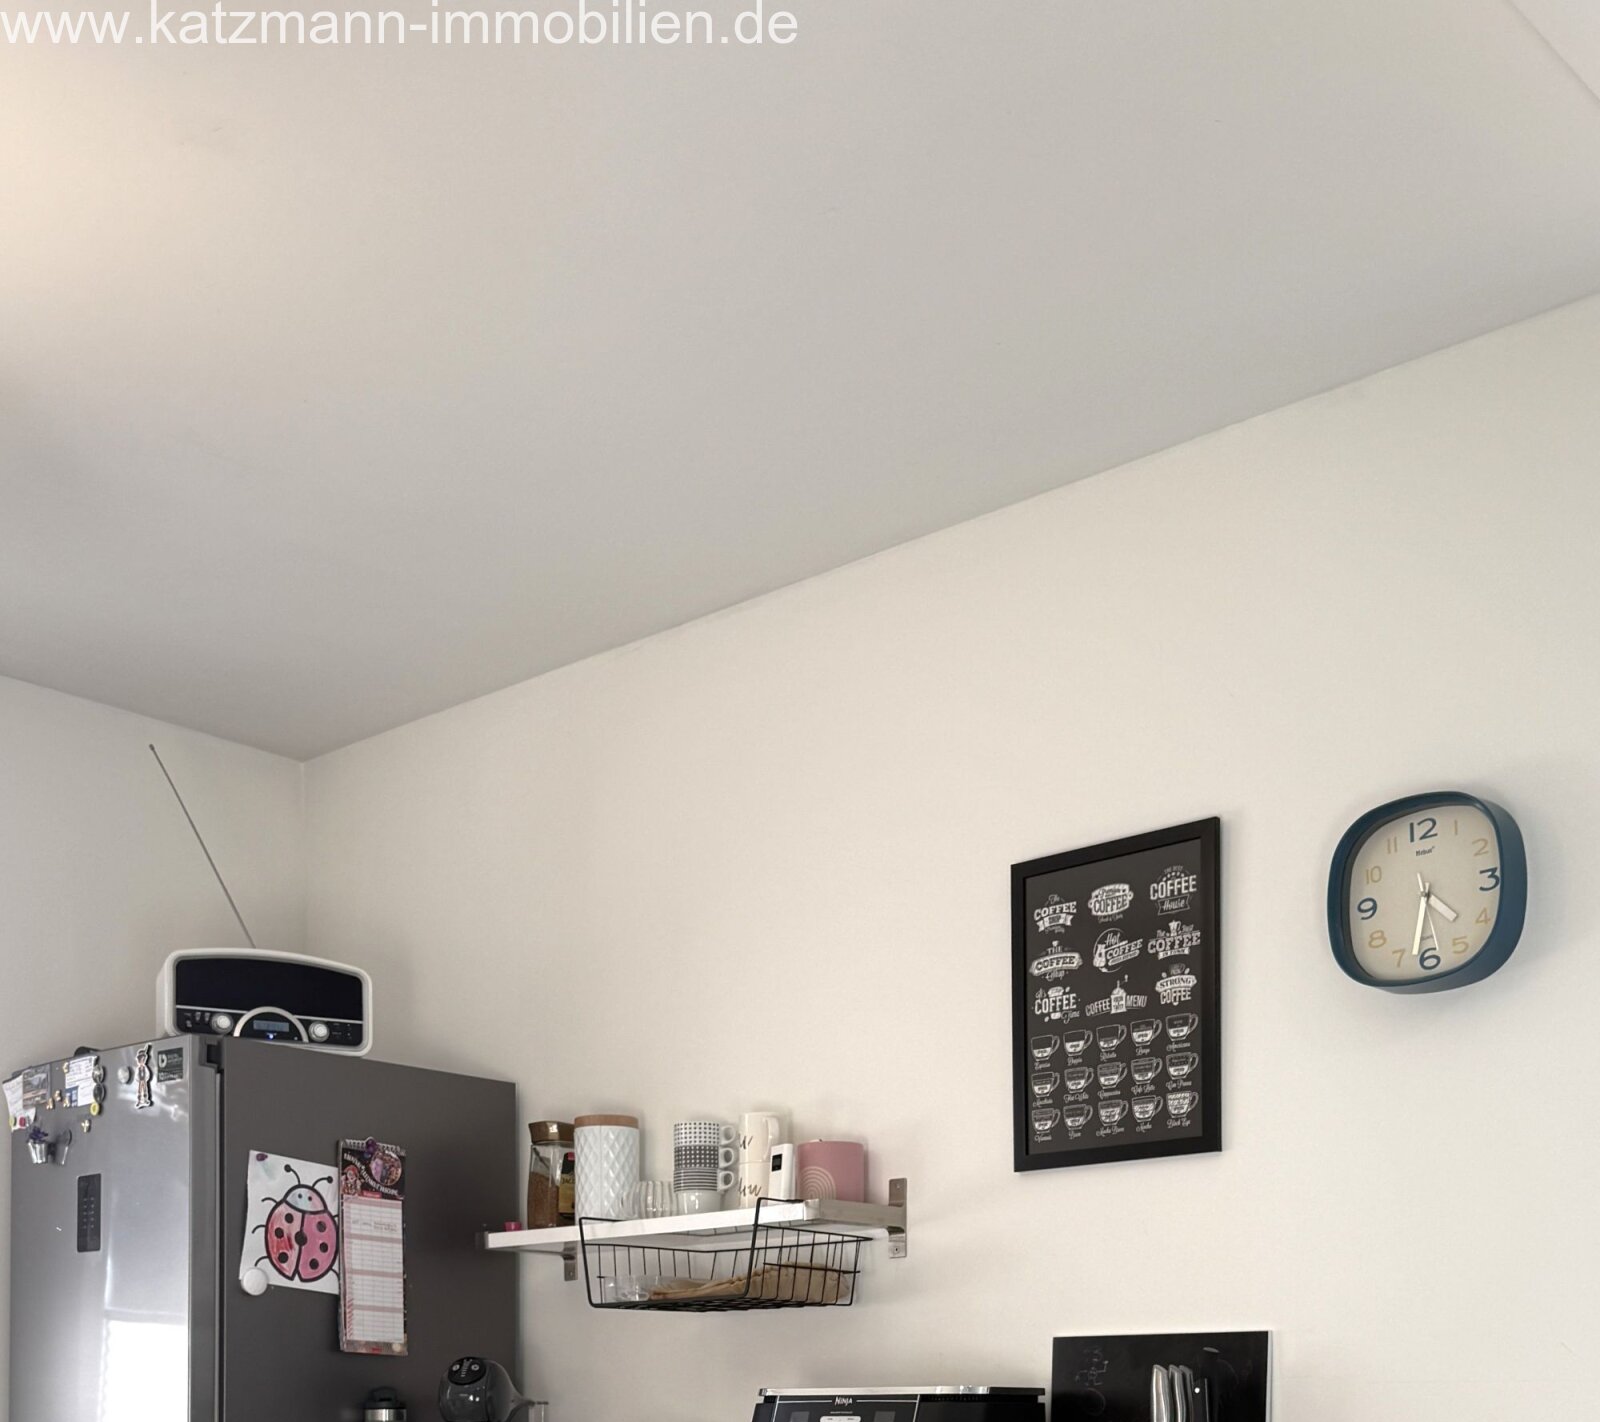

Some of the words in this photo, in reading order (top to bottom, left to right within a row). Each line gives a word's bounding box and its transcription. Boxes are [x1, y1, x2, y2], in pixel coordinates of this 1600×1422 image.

[1409, 818, 1438, 843] 12
[1454, 819, 1459, 836] 1
[1386, 837, 1398, 855] 11
[1471, 838, 1489, 857] 2
[1366, 865, 1382, 885] 10
[1479, 867, 1500, 891] 3
[1150, 875, 1197, 900] COFFEE
[1034, 901, 1077, 921] COFFEE
[1094, 894, 1129, 913] COFFEE
[1357, 897, 1378, 920] 9
[1475, 907, 1491, 926] 4
[1106, 938, 1143, 960] COFFEE
[1147, 931, 1200, 954] COFFEE
[1368, 930, 1387, 949] 8
[1452, 936, 1470, 954] 5
[1035, 955, 1076, 971] COFFEE
[1392, 948, 1406, 967] 7
[1419, 947, 1441, 970] 6
[1160, 977, 1192, 988] STRONG
[1034, 993, 1077, 1015] COFFEE
[1085, 998, 1111, 1016] COFFEE
[1126, 995, 1148, 1008] MENU
[1160, 987, 1192, 1006] COFFEE
